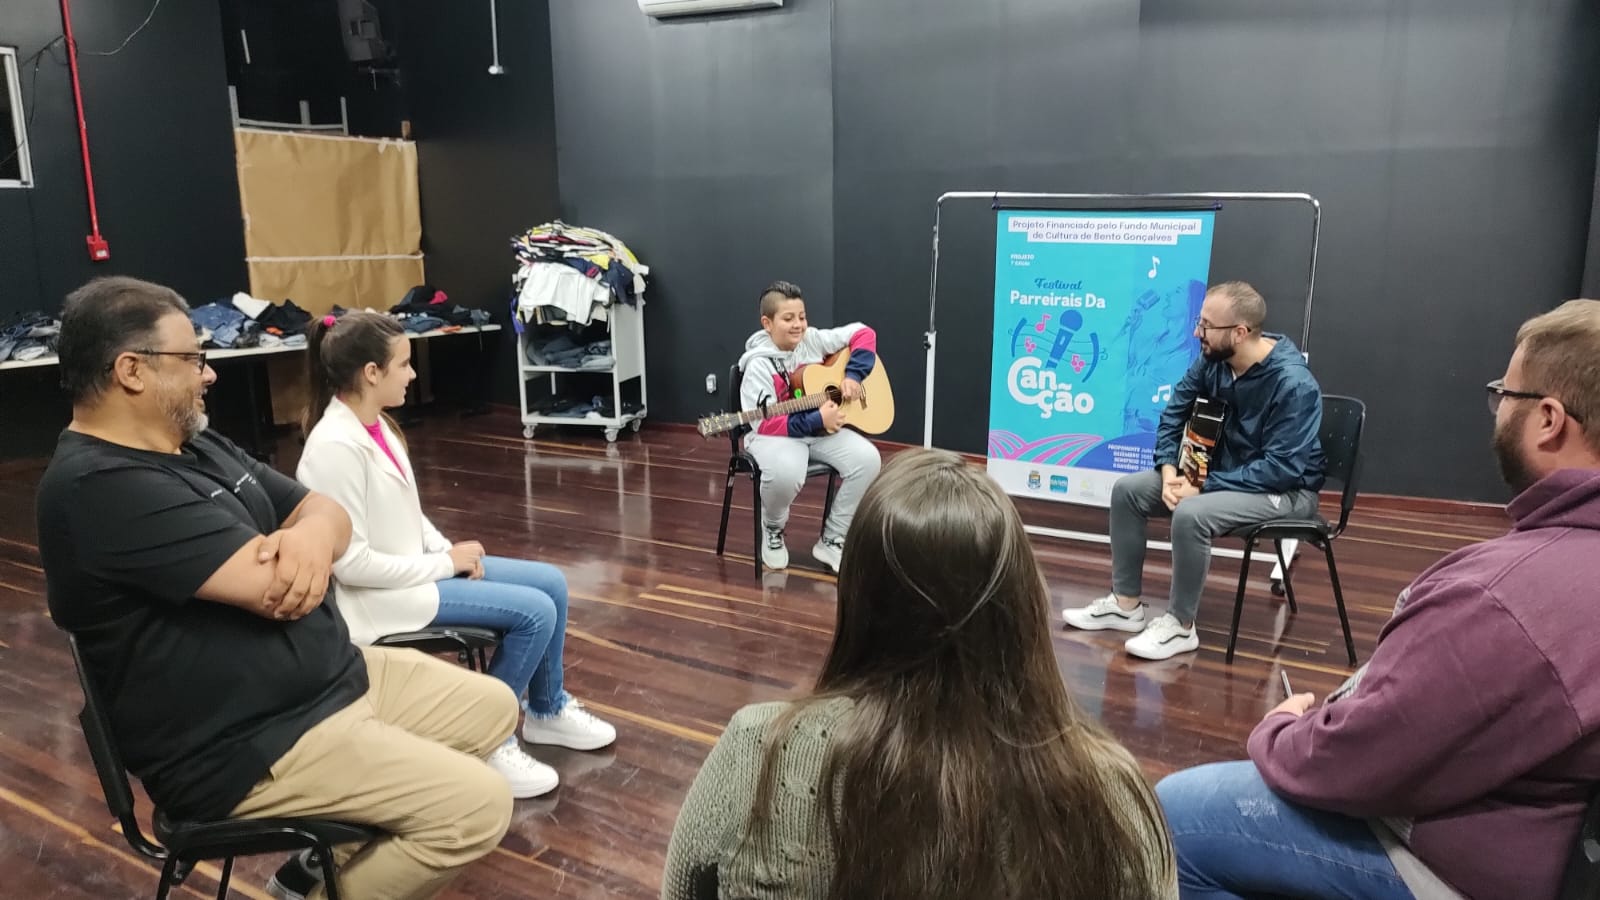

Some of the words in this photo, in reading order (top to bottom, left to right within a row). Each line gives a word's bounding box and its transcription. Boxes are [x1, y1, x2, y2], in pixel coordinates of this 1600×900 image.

[1012, 220, 1045, 230] Projeto
[1046, 220, 1095, 230] Financiado
[1096, 221, 1118, 231] pelo
[1119, 221, 1148, 231] Fundo
[1149, 222, 1196, 232] Municipal
[1032, 231, 1044, 240] de
[1045, 231, 1079, 240] Cultura
[1080, 232, 1092, 241] de
[1093, 232, 1121, 241] Bento
[1123, 232, 1173, 243] Gonçalves
[1034, 278, 1083, 289] Festival
[1010, 290, 1082, 306] Parreirais
[1084, 292, 1106, 309] Da
